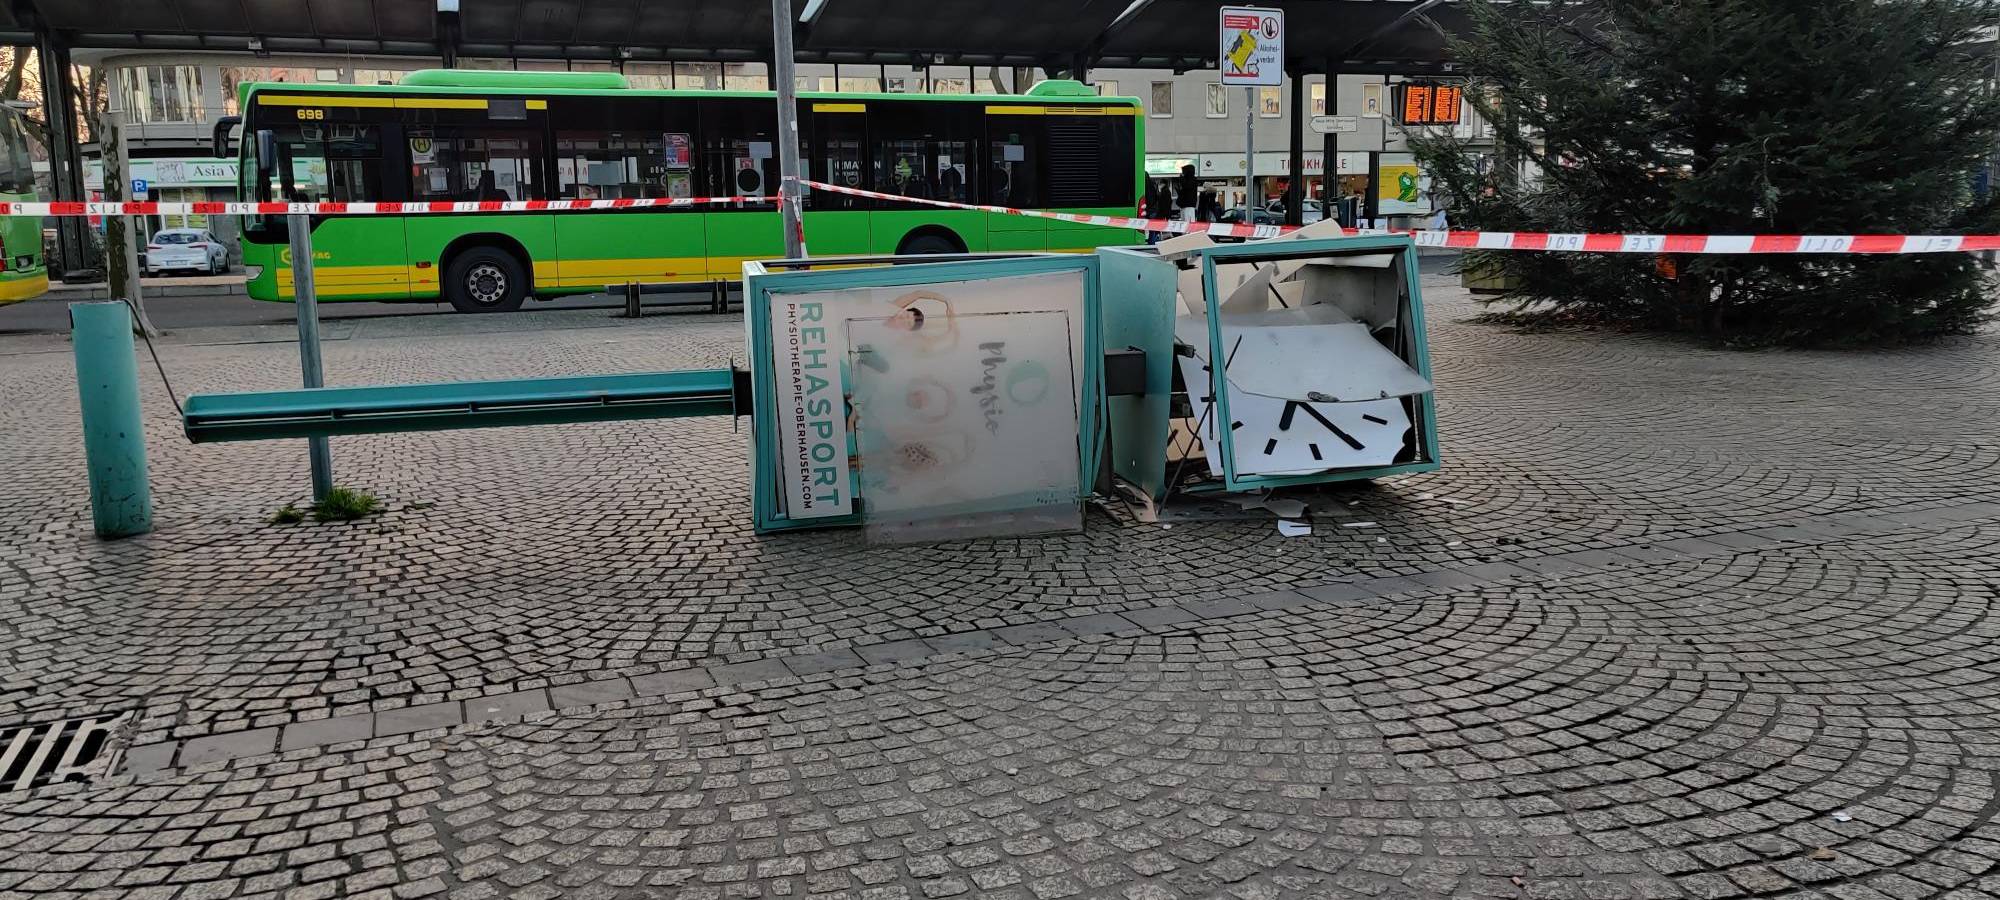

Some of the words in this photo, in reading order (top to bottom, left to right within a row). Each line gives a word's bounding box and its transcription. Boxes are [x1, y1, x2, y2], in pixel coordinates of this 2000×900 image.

[297, 109, 324, 120] 698
[193, 165, 225, 177] Asia
[786, 303, 812, 509] PHYSIOTHERAPIE-OBERHAUSEN.COM
[800, 302, 840, 507] REHASPORT
[969, 341, 1007, 437] Physio
